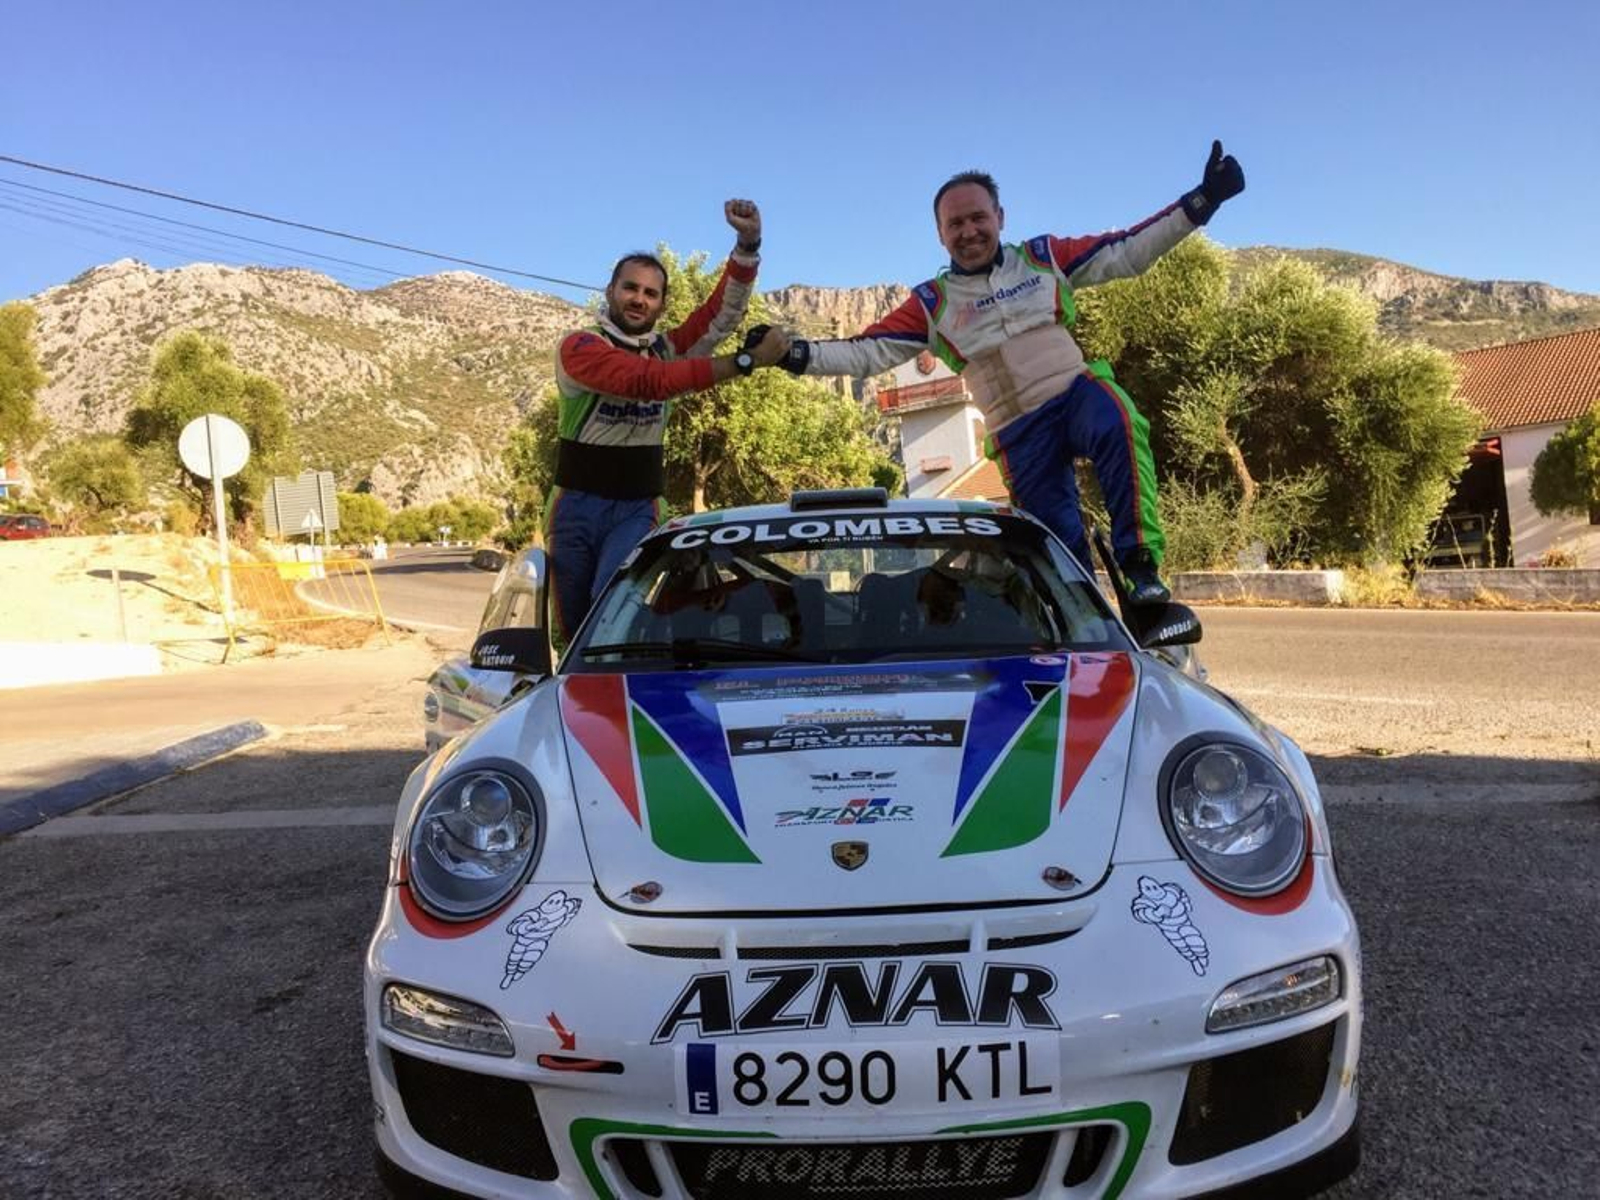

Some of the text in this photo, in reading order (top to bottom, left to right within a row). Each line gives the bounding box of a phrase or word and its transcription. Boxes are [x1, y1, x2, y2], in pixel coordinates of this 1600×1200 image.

[670, 517, 1002, 549] COLOMBES
[742, 732, 953, 750] SERVIMAN
[776, 804, 914, 822] AZNAR
[650, 961, 1063, 1045] AZNAR
[694, 1040, 1053, 1112] E 8290 KTL
[704, 1137, 1024, 1183] PRORALLYE
